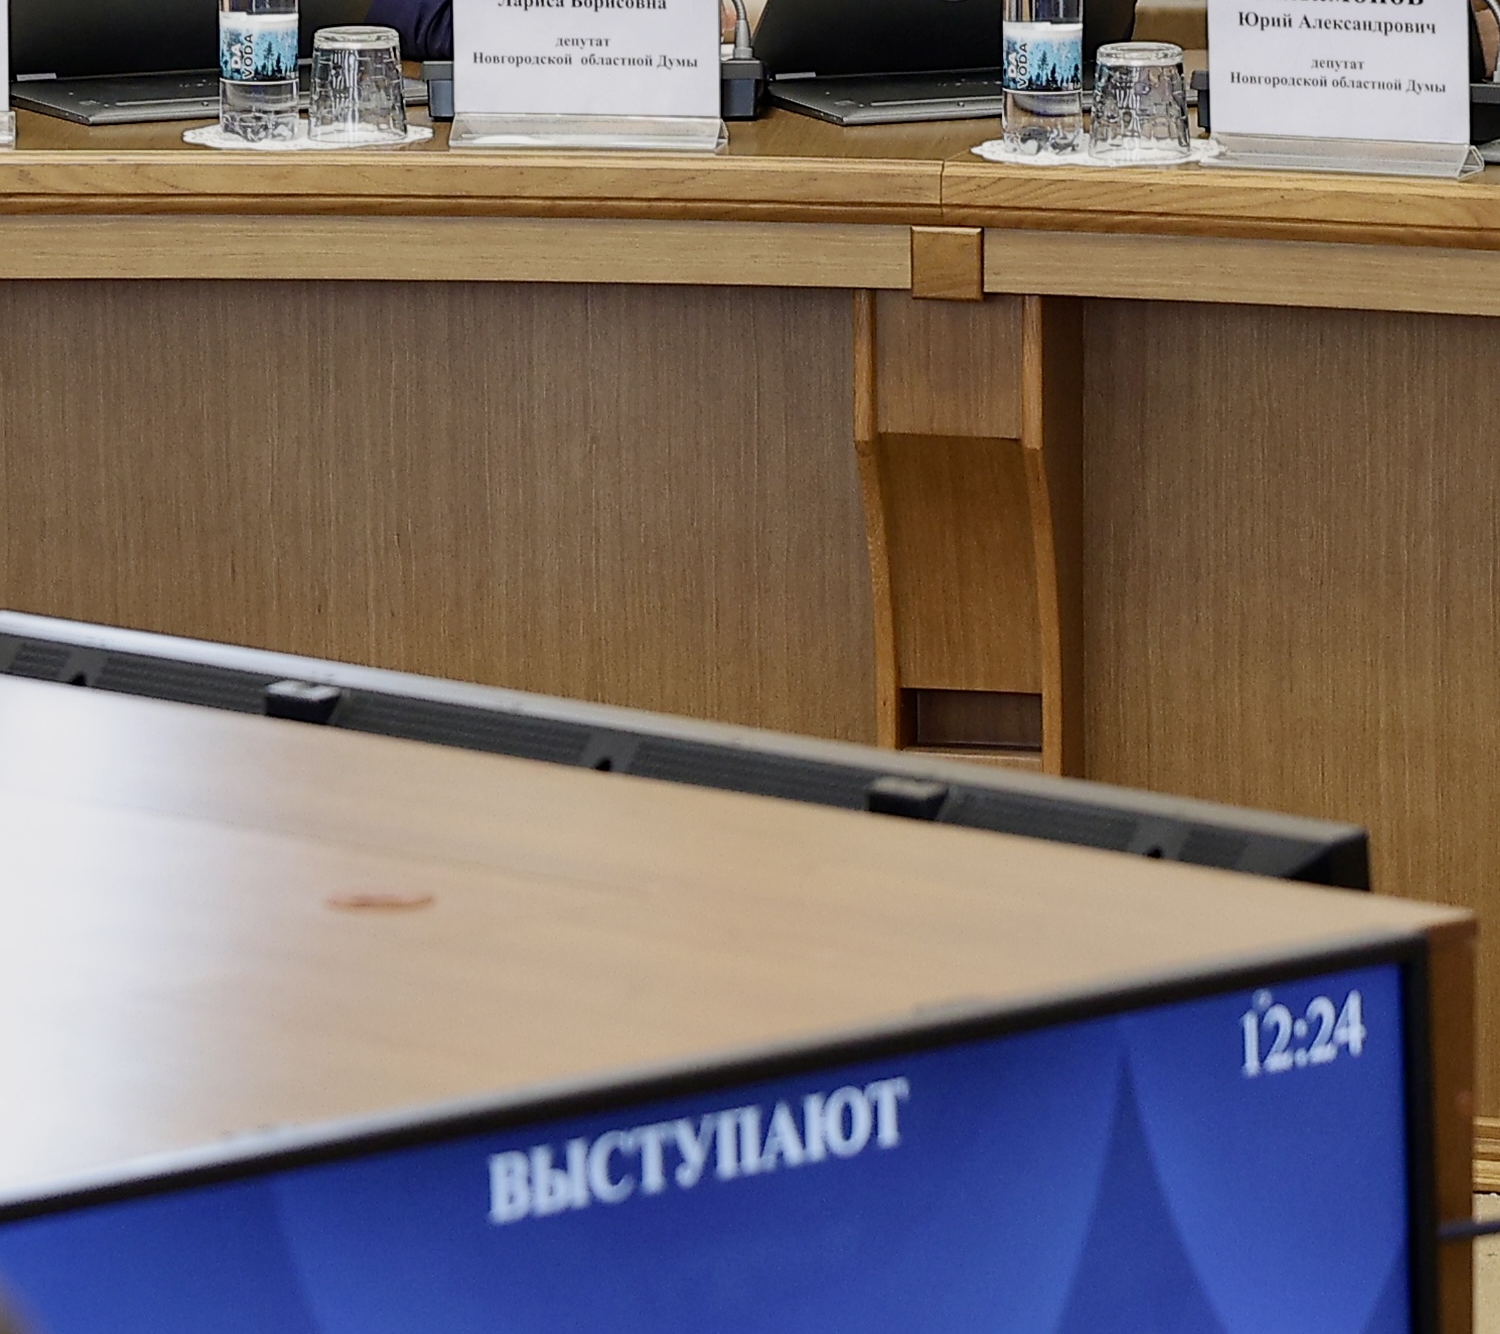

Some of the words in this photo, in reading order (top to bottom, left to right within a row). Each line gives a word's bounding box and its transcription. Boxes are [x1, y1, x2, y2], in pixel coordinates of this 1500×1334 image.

[1238, 11, 1293, 32] Юрий
[1298, 14, 1436, 36] Александрович
[244, 33, 253, 79] VODA
[555, 37, 610, 50] депутат
[472, 51, 572, 68] Новгородской
[580, 53, 653, 67] областной
[656, 54, 698, 70] Думы
[1018, 42, 1028, 87] VODA
[1311, 58, 1365, 71] депутат
[1230, 71, 1327, 88] Новгородской
[1331, 76, 1402, 91] областной
[1405, 79, 1447, 95] Думы
[1239, 989, 1368, 1078] 12:24
[488, 1076, 910, 1225] ВЫСТУПАЮТ
